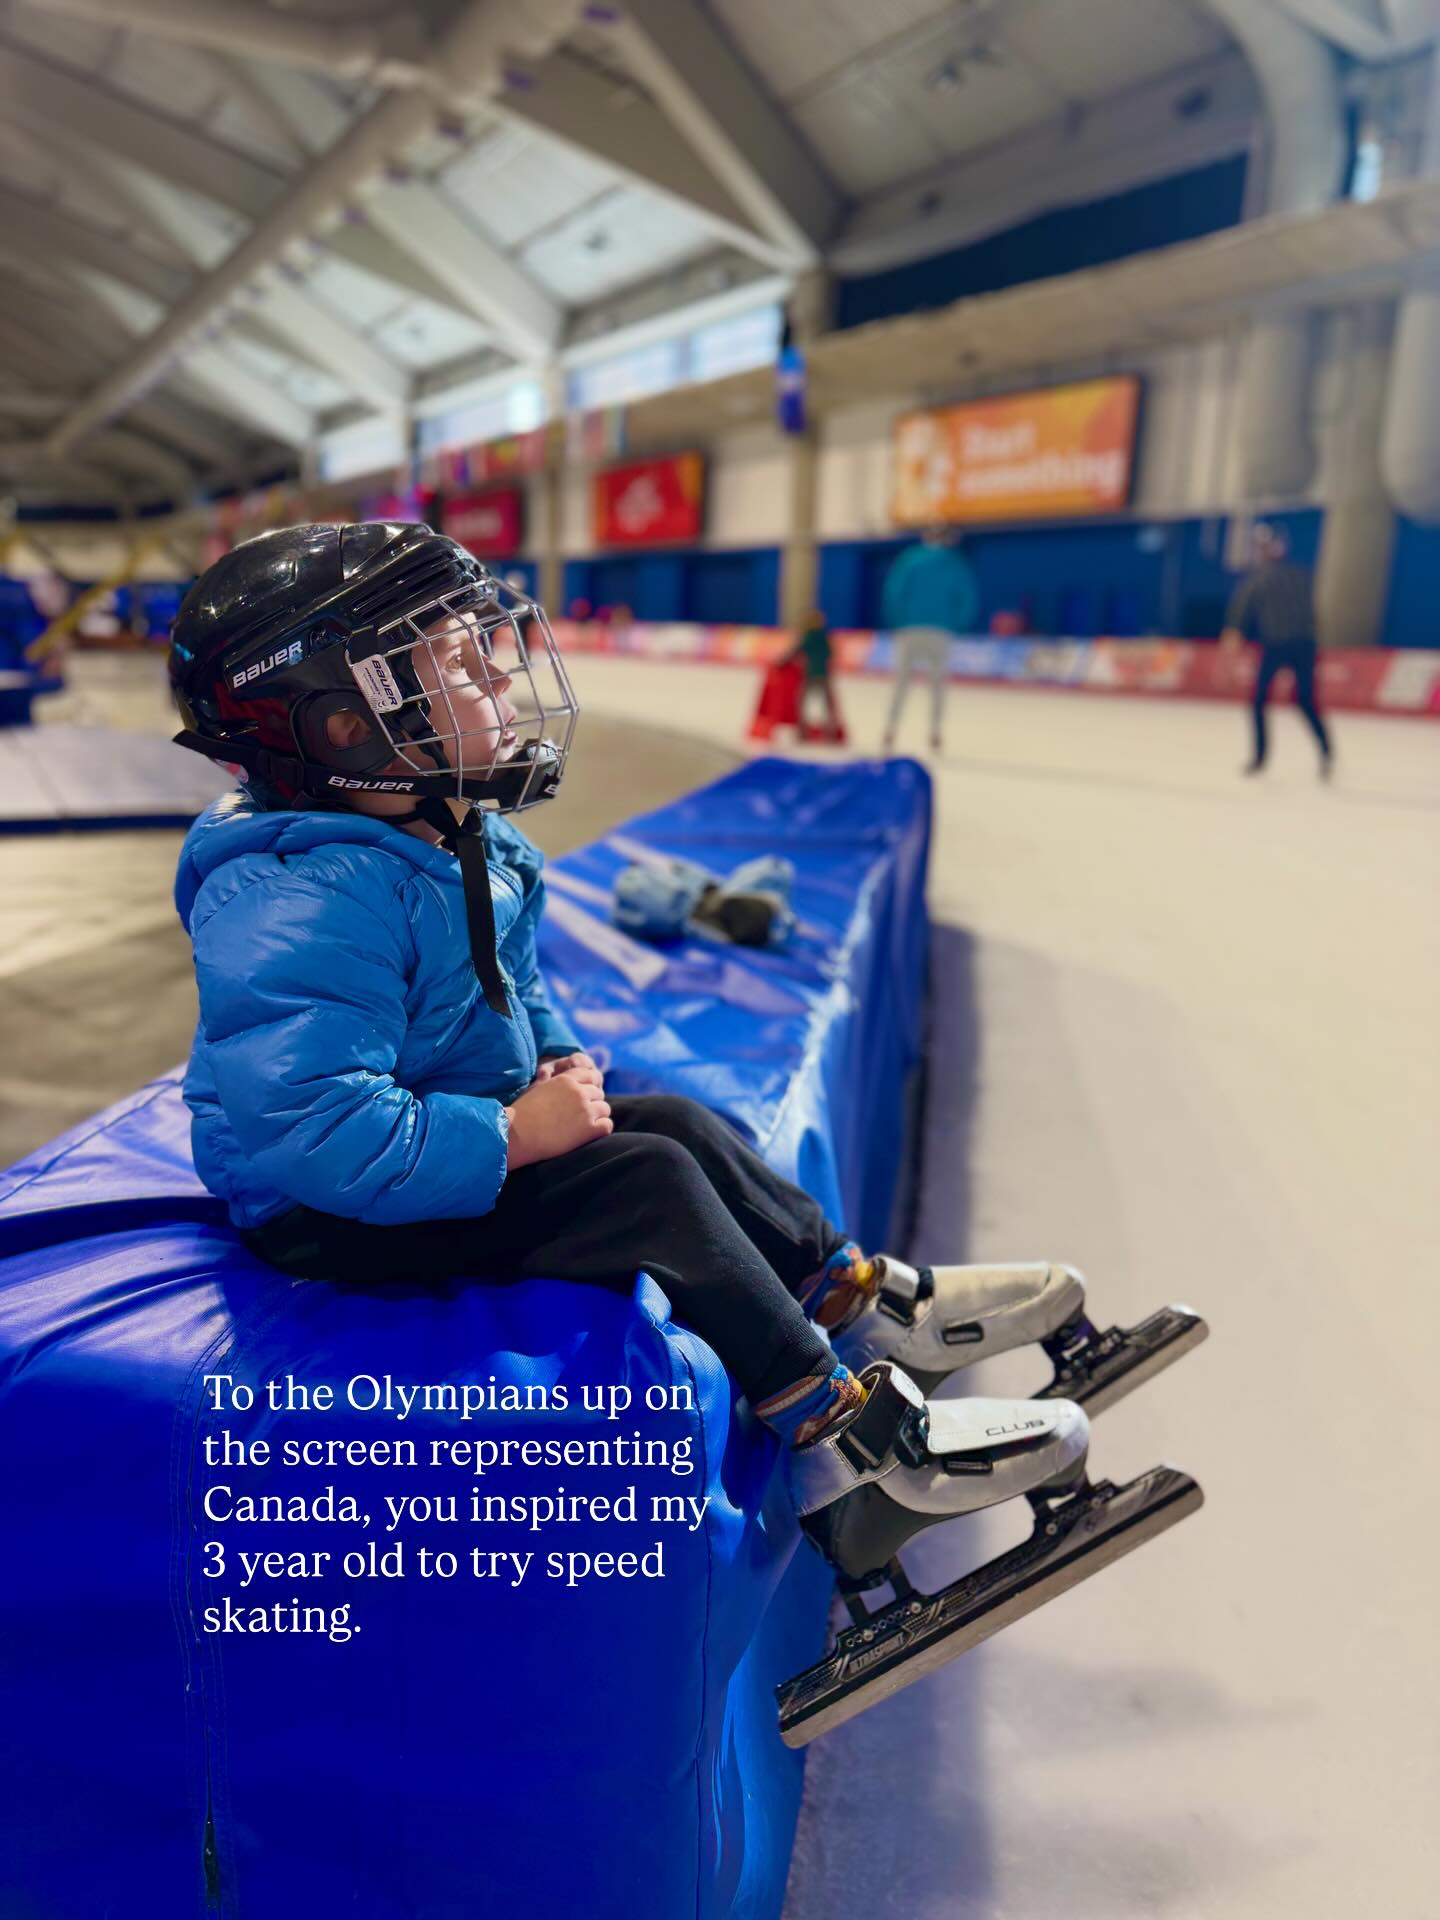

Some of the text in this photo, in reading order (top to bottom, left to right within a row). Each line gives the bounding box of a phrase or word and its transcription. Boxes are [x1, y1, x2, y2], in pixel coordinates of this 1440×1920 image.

[232, 640, 304, 689] BAUER
[372, 659, 398, 706] BAUER
[327, 775, 415, 792] BAUER
[984, 1419, 1046, 1437] CLUB
